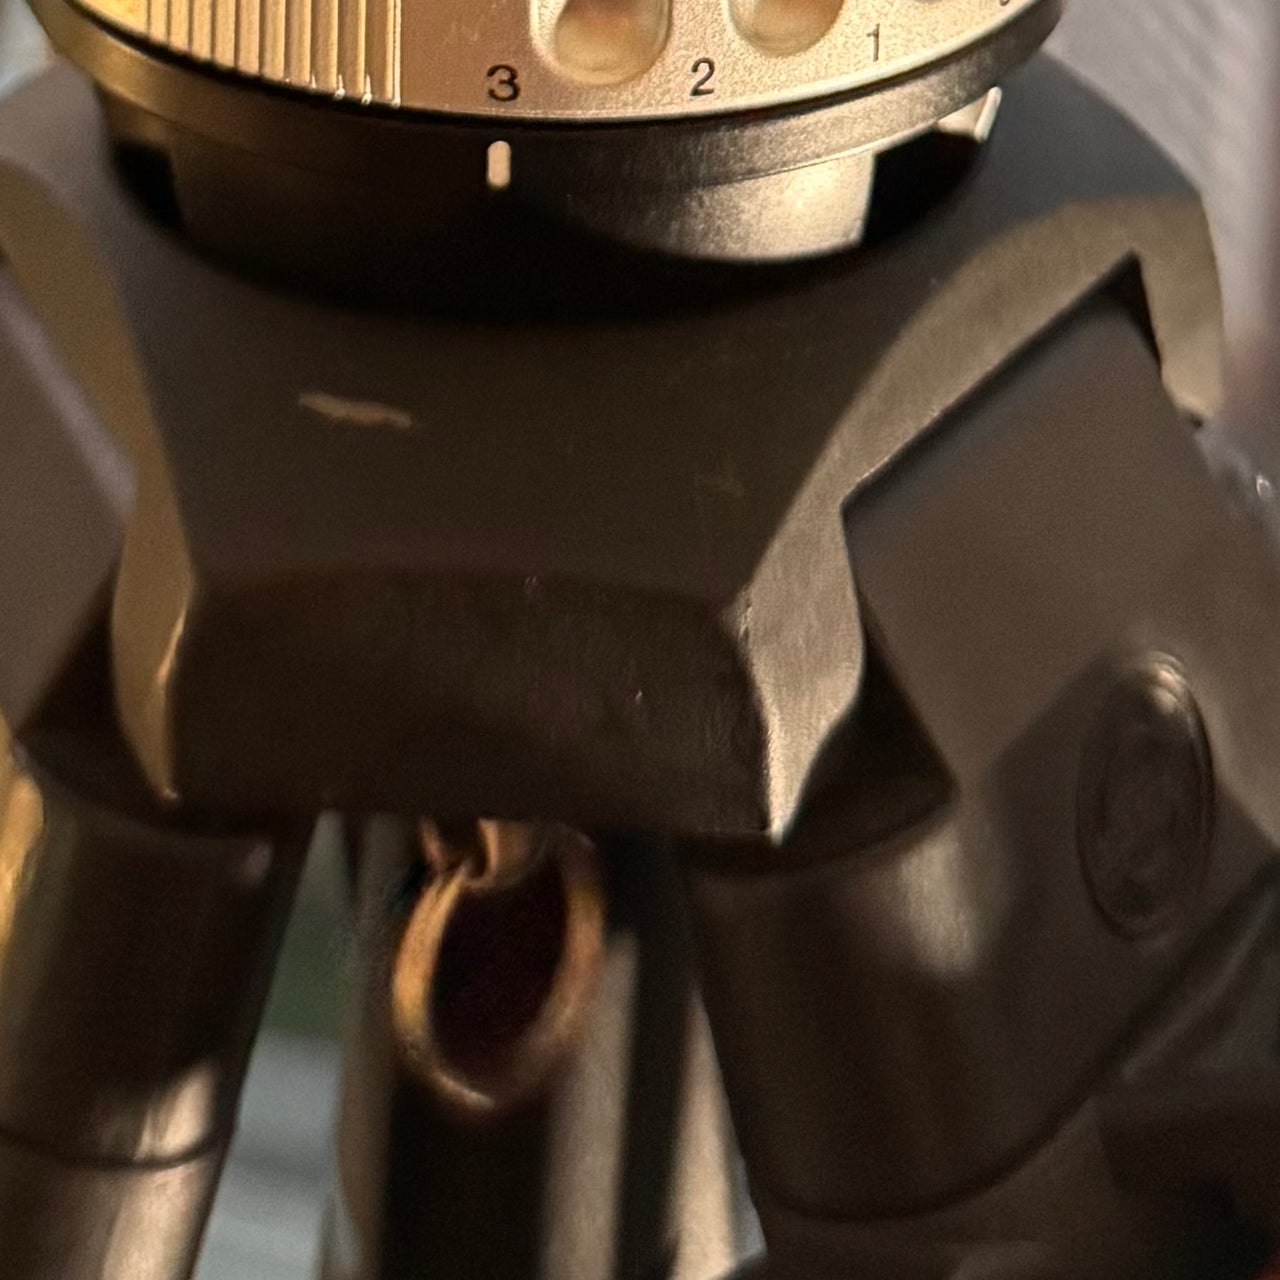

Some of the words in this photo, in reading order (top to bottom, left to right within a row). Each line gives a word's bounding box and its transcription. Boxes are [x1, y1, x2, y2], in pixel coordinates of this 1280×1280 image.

[486, 63, 521, 102] 3
[689, 56, 716, 97] 2
[866, 23, 882, 62] 1
